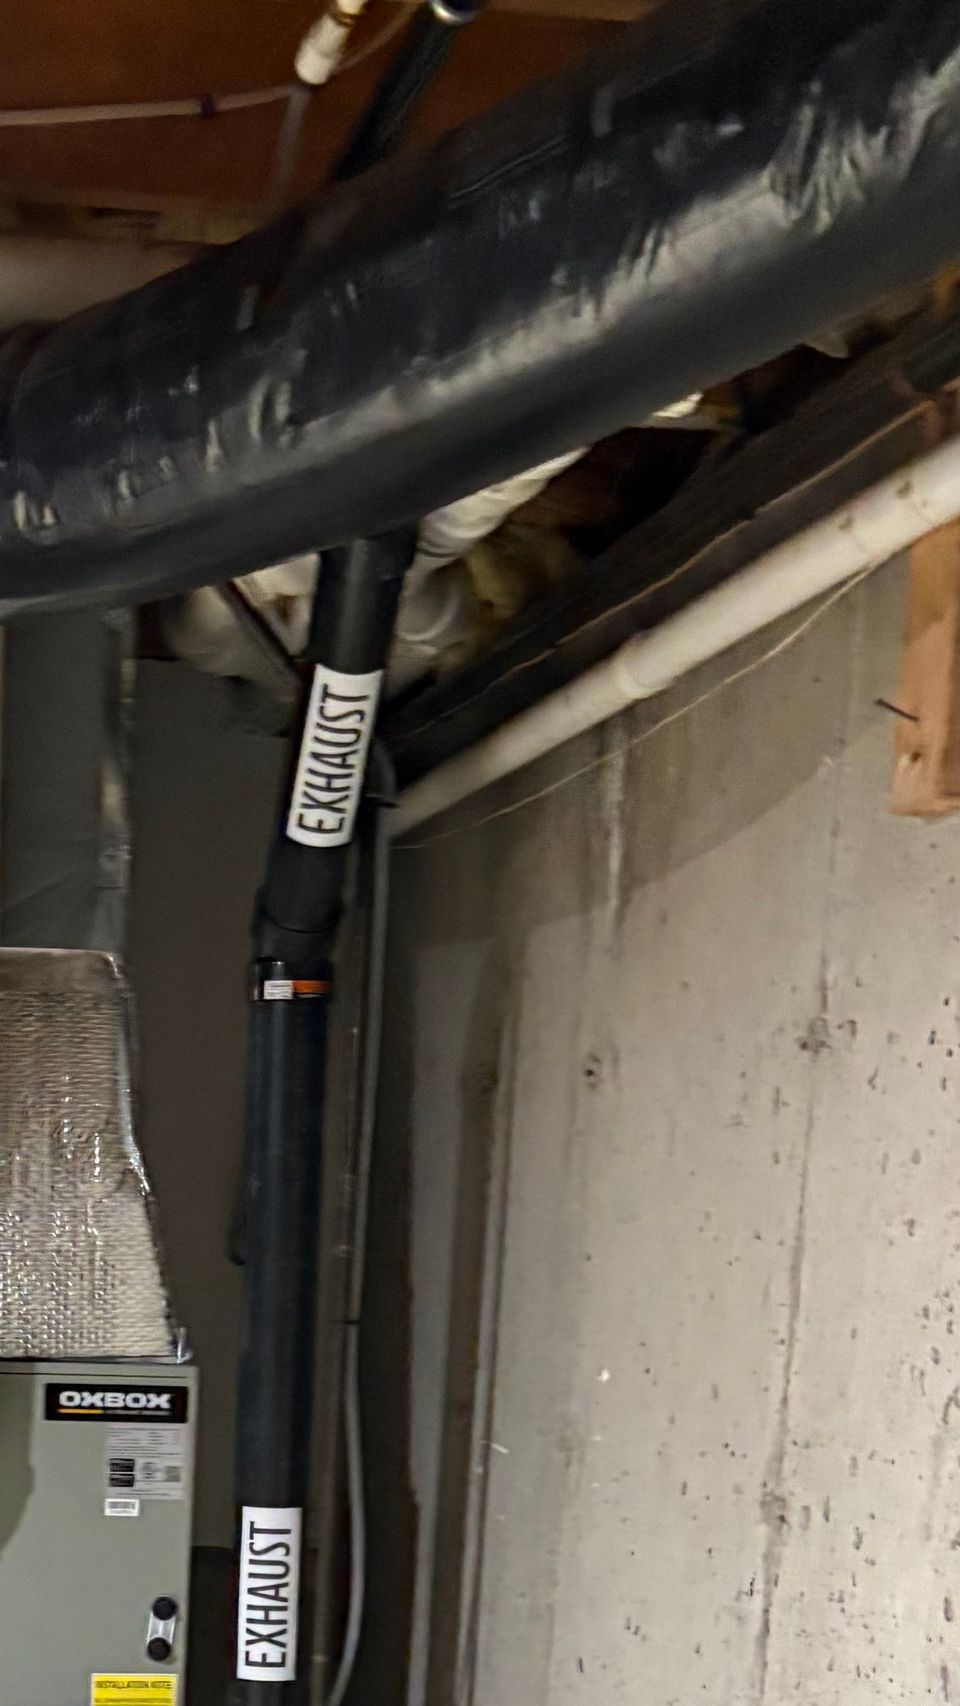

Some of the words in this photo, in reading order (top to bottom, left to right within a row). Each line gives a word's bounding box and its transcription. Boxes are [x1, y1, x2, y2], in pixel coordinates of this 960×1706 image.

[297, 683, 370, 834] EXHAUST
[58, 1391, 172, 1408] OXBOX
[245, 1521, 292, 1667] EXHAUST
